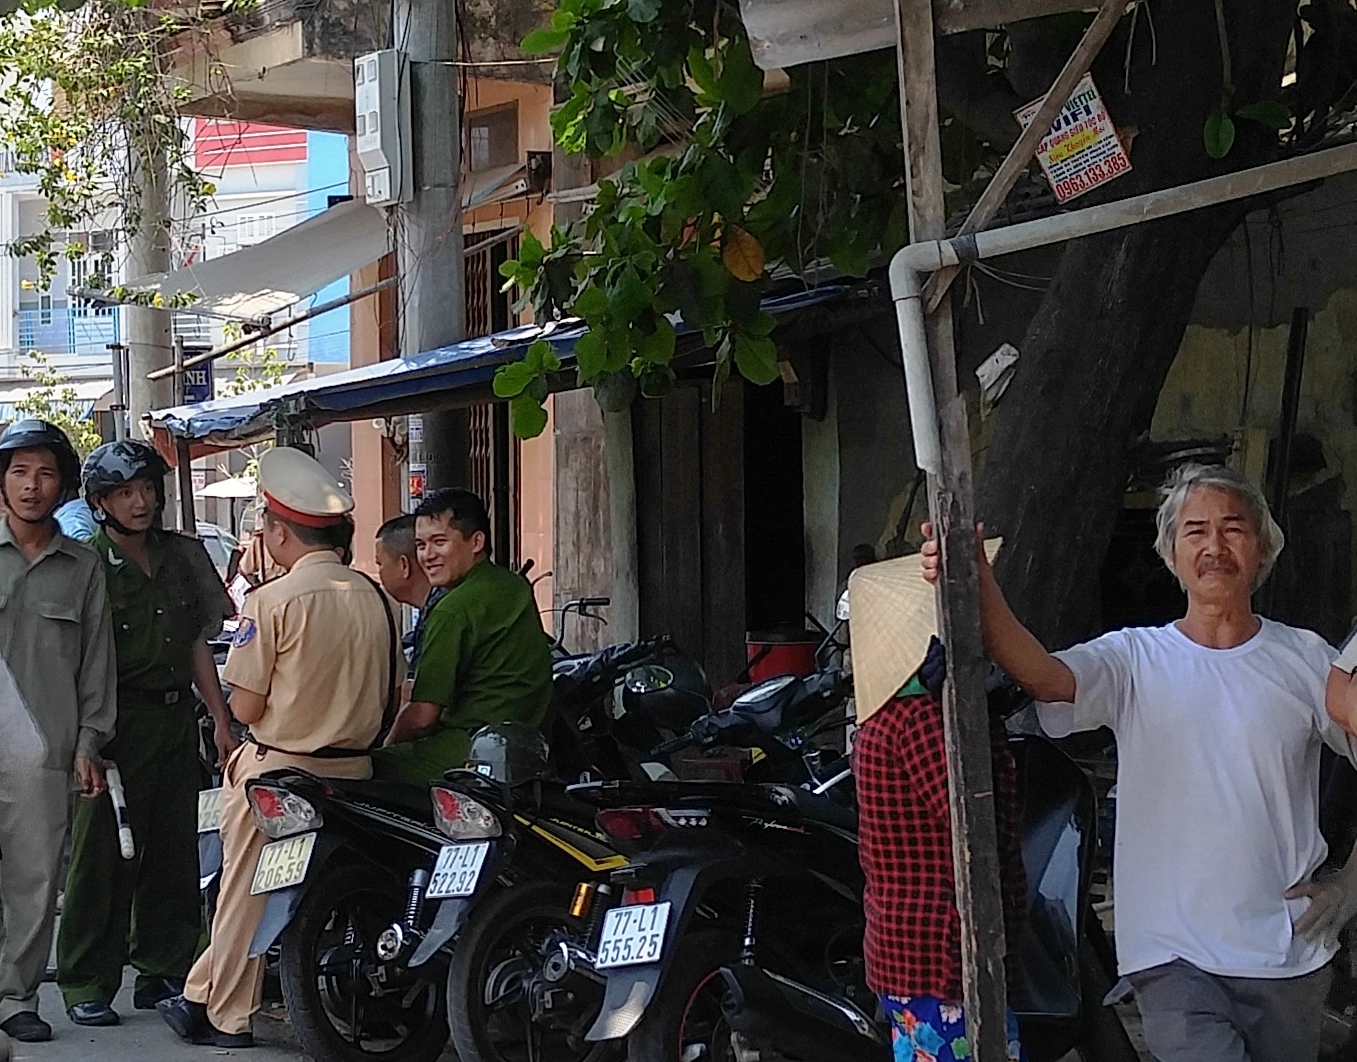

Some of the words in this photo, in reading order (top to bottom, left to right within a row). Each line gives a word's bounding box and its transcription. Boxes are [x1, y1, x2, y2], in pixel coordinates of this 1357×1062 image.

[1055, 152, 1127, 200] 0963.133.385
[430, 870, 476, 895] 522.92
[599, 934, 660, 965] 555.25
